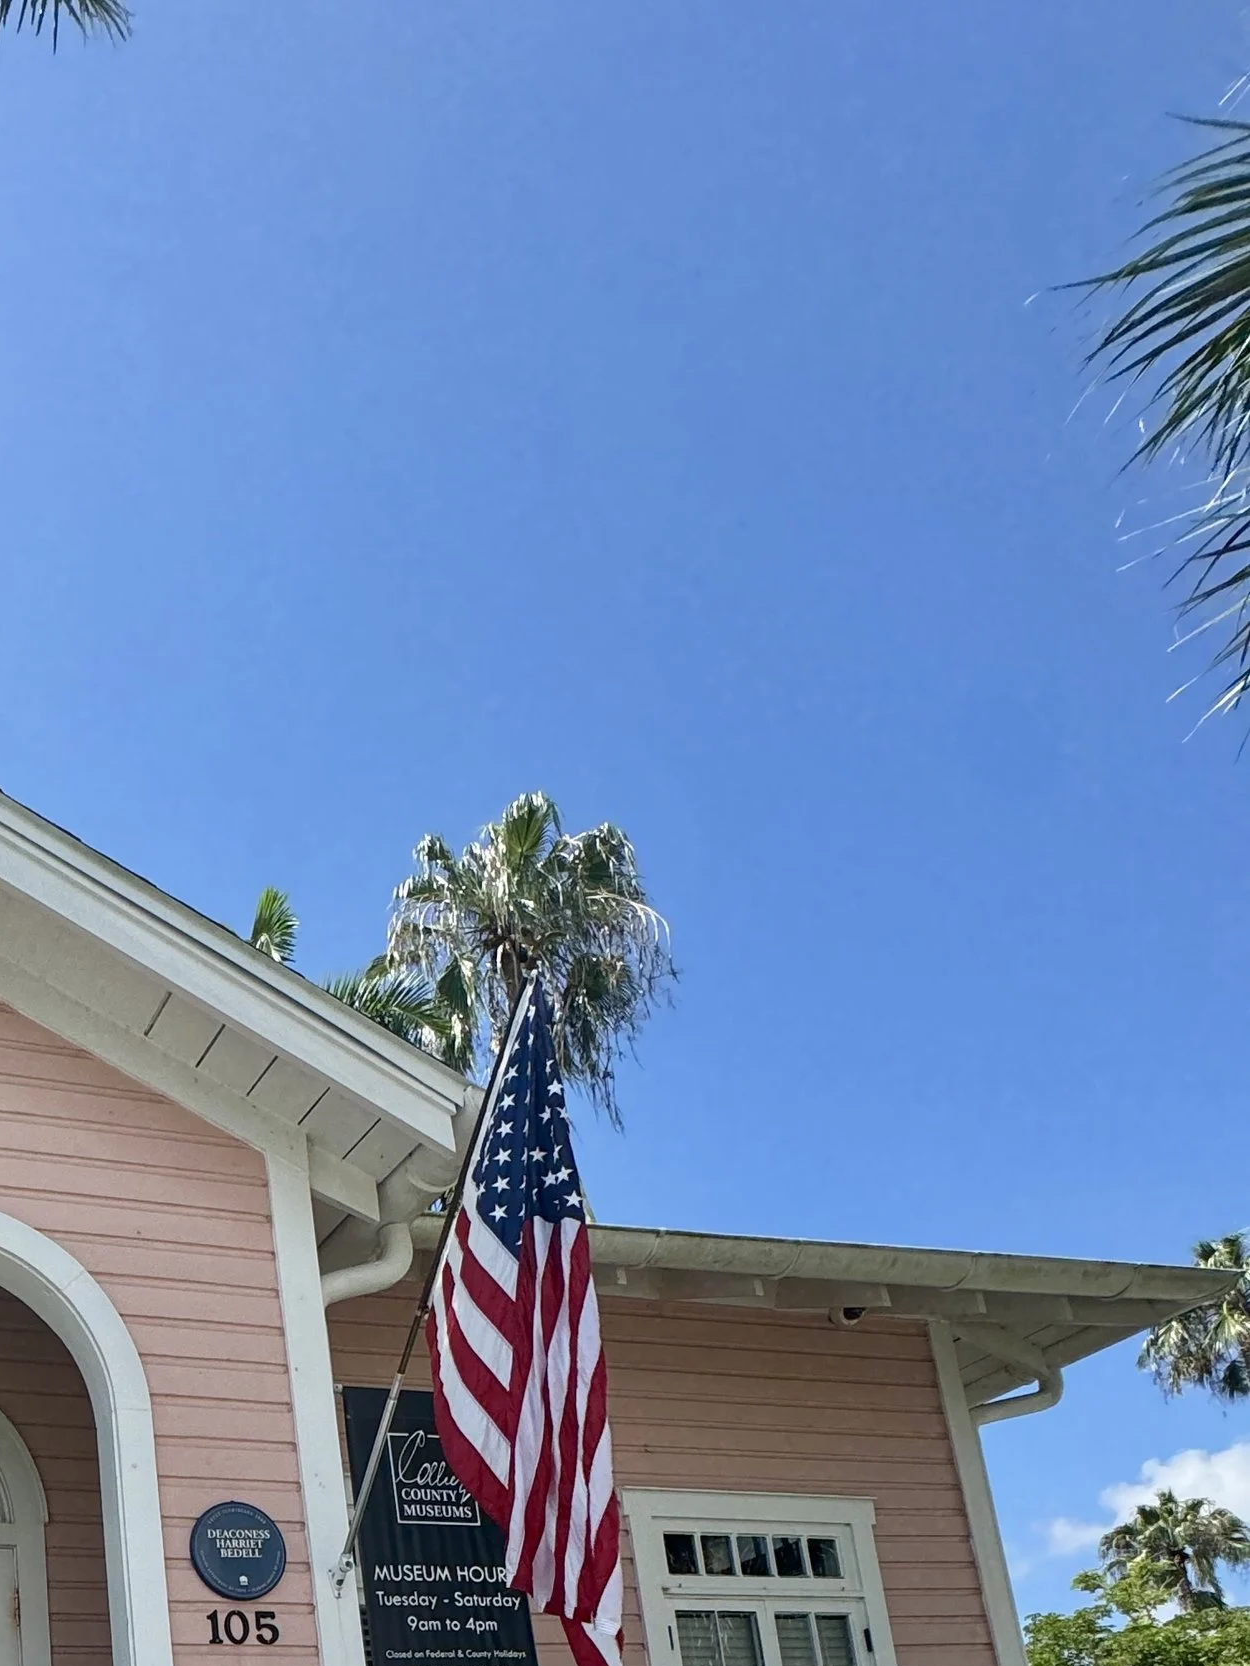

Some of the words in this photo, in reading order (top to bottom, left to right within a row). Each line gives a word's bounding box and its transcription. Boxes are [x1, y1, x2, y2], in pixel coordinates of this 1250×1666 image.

[401, 1488, 457, 1502] COUNTY
[403, 1504, 473, 1518] MUSEUMS
[207, 1529, 271, 1539] DEACONESS
[216, 1538, 263, 1548] HARRIET
[220, 1548, 262, 1558] BEDELL
[374, 1564, 451, 1582] MUSEUM
[456, 1566, 508, 1583] HOUR
[375, 1591, 437, 1610] Tuesday
[454, 1591, 521, 1610] Saturday
[206, 1609, 279, 1644] 105
[407, 1616, 442, 1631] 9am
[445, 1618, 460, 1631] to
[465, 1617, 498, 1634] 4pm
[385, 1650, 412, 1658] Closed
[425, 1650, 455, 1658] Federal
[457, 1649, 464, 1658] &
[465, 1650, 491, 1659] County
[493, 1650, 526, 1659] Holidays
